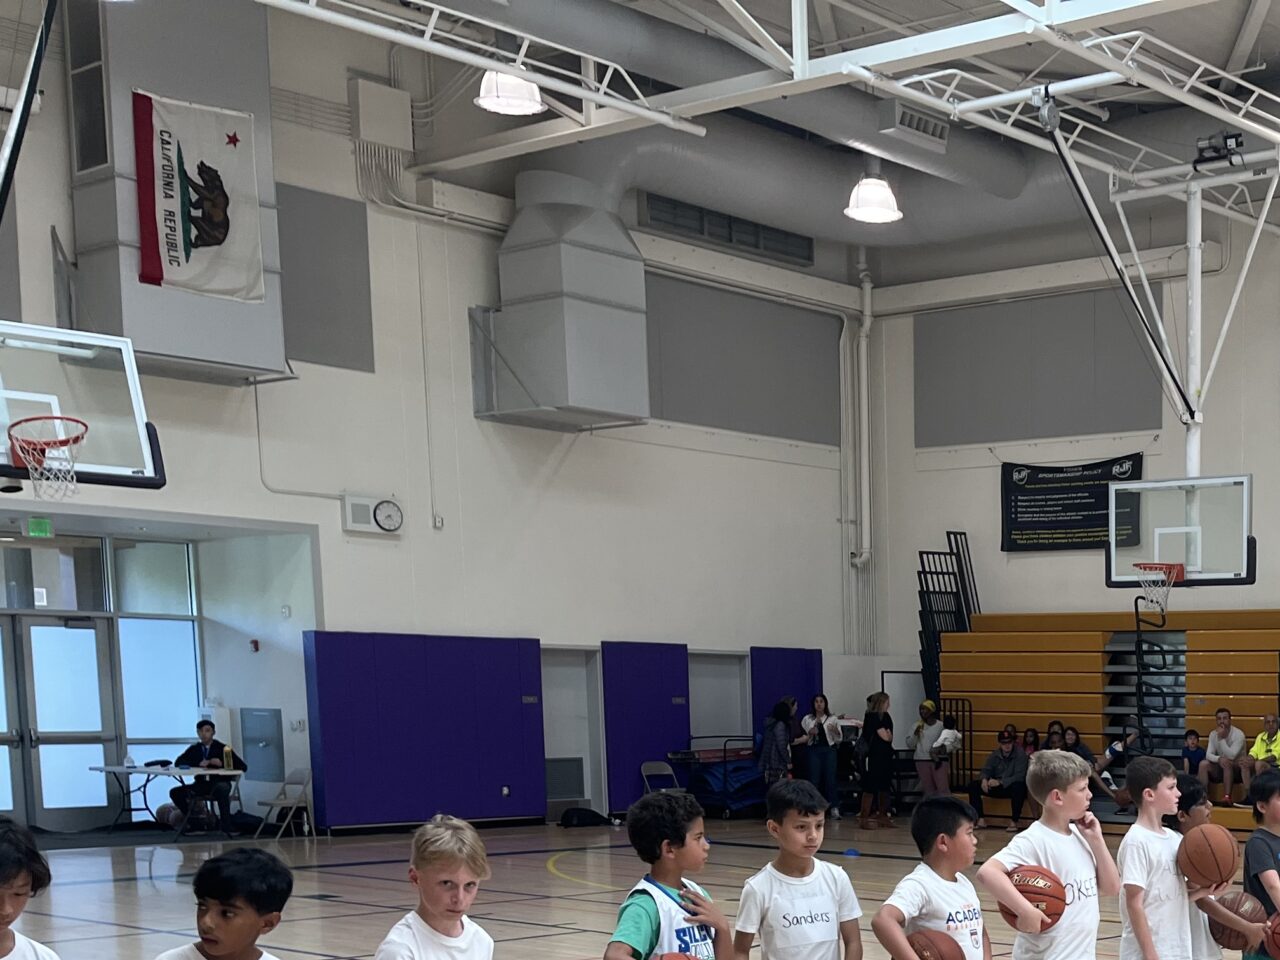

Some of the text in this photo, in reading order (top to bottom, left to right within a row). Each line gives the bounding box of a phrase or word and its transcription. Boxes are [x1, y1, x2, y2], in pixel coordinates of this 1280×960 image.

[159, 129, 181, 267] CALIFORNIA REPUBLIC
[1112, 460, 1133, 476] RJF
[782, 910, 831, 929] Sanders
